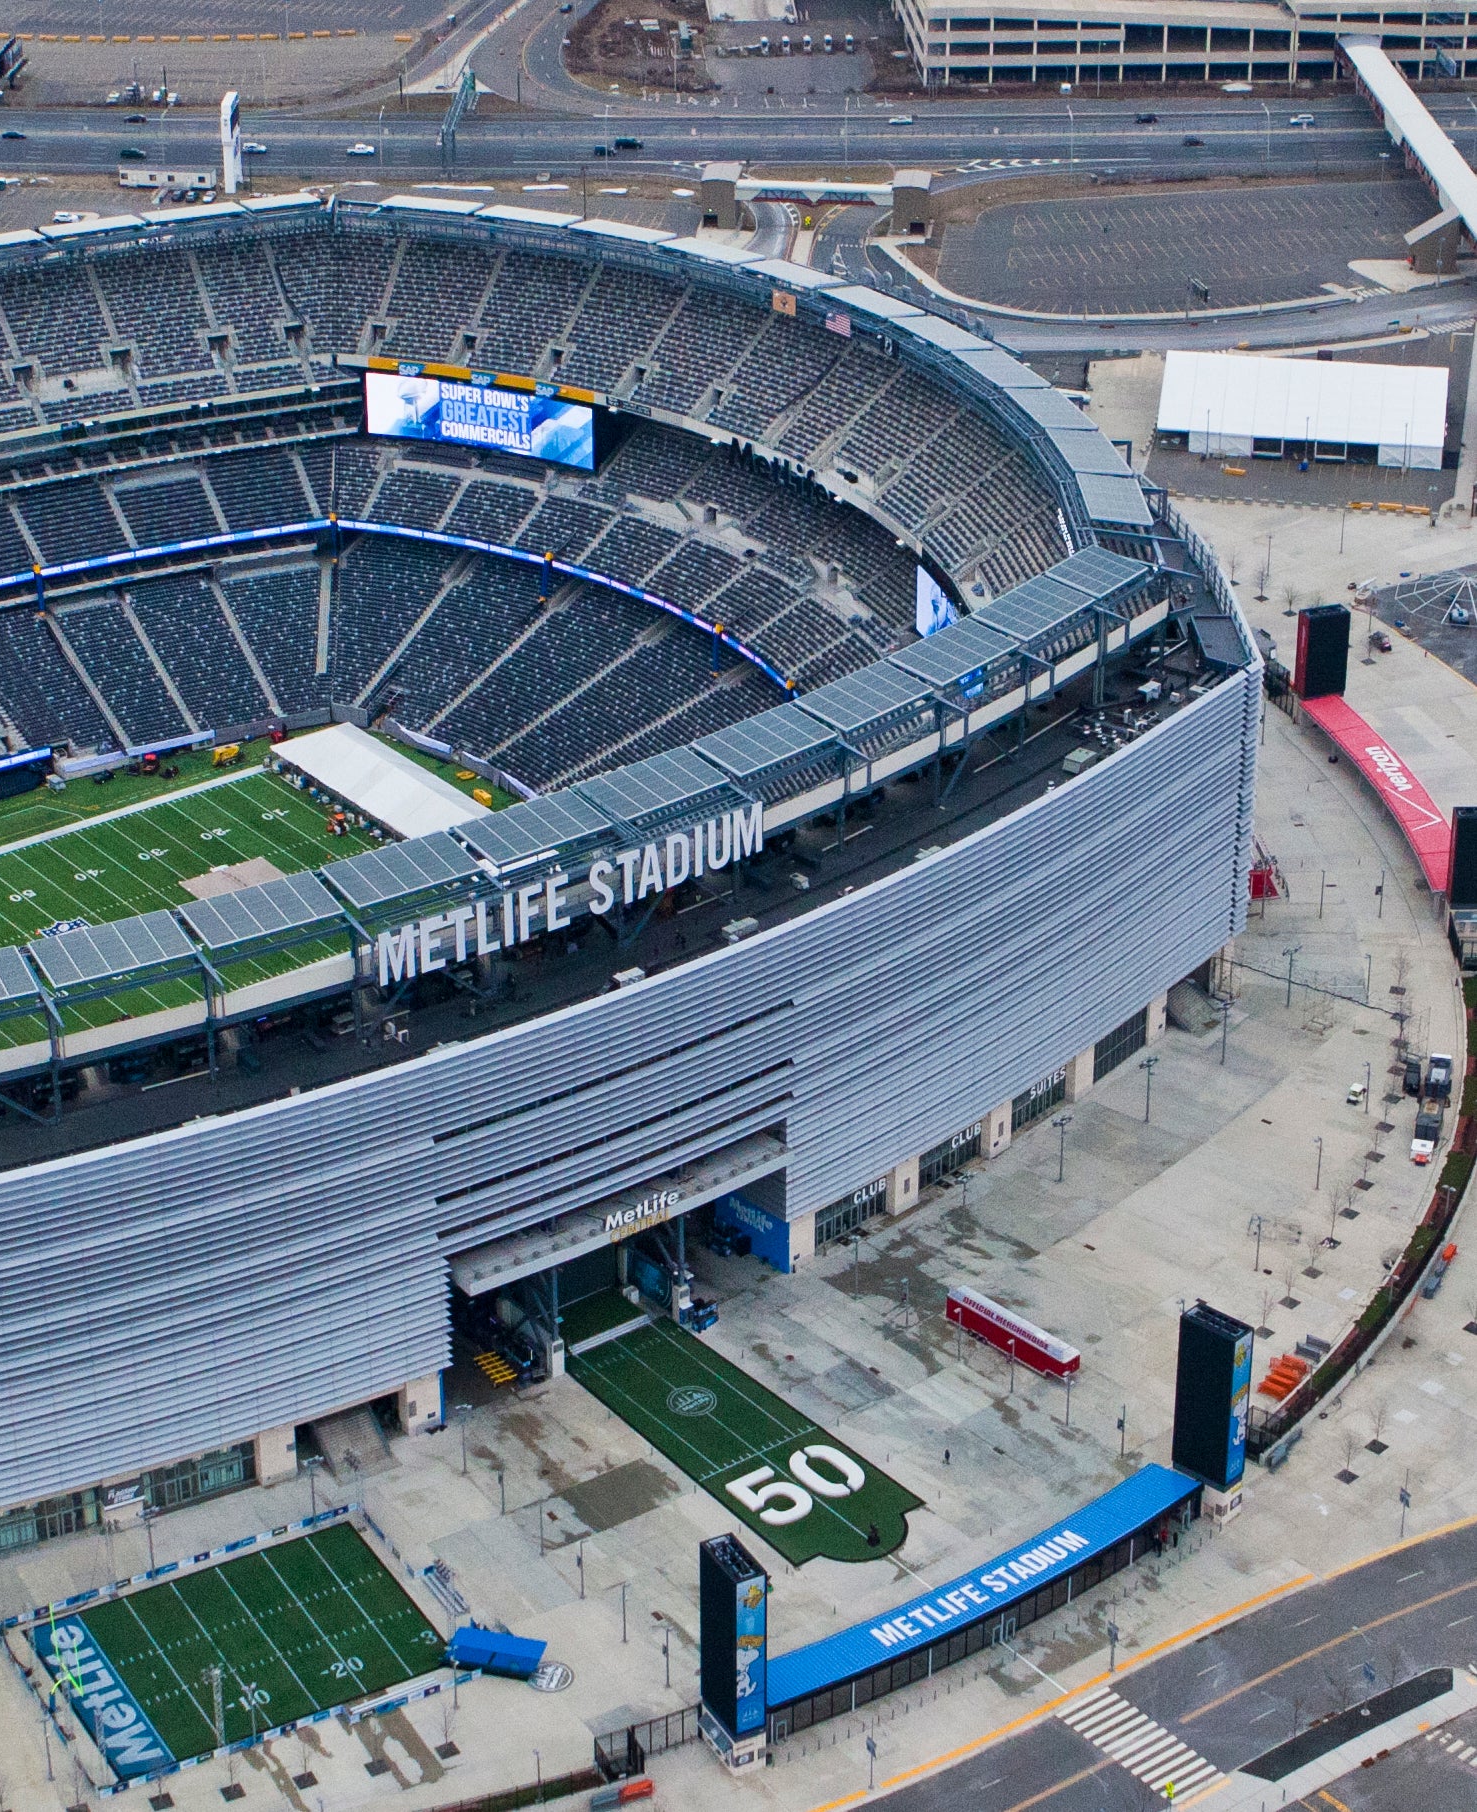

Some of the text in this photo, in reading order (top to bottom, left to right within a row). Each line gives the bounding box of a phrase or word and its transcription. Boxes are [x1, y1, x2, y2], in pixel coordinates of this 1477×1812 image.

[398, 363, 420, 377] SAP
[471, 373, 491, 387] SAP
[441, 383, 530, 412] SUPER BOWL'S
[535, 383, 555, 397] SAP
[440, 400, 531, 433] GREATEST
[441, 420, 532, 450] COMMERCIALS
[1364, 745, 1413, 792] verizon
[377, 801, 764, 986] METLIFE STADIUM
[1030, 1066, 1067, 1100] SUITES
[951, 1122, 982, 1149] CLUB
[853, 1177, 887, 1205] CLUB
[604, 1190, 680, 1232] MetLife
[963, 1296, 1050, 1350] OFFICIAL MERCHANDISE
[724, 1444, 866, 1526] 50
[870, 1529, 1090, 1647] METLIFE STADIUM
[329, 1656, 365, 1679] 20
[45, 1624, 164, 1766] MetLife
